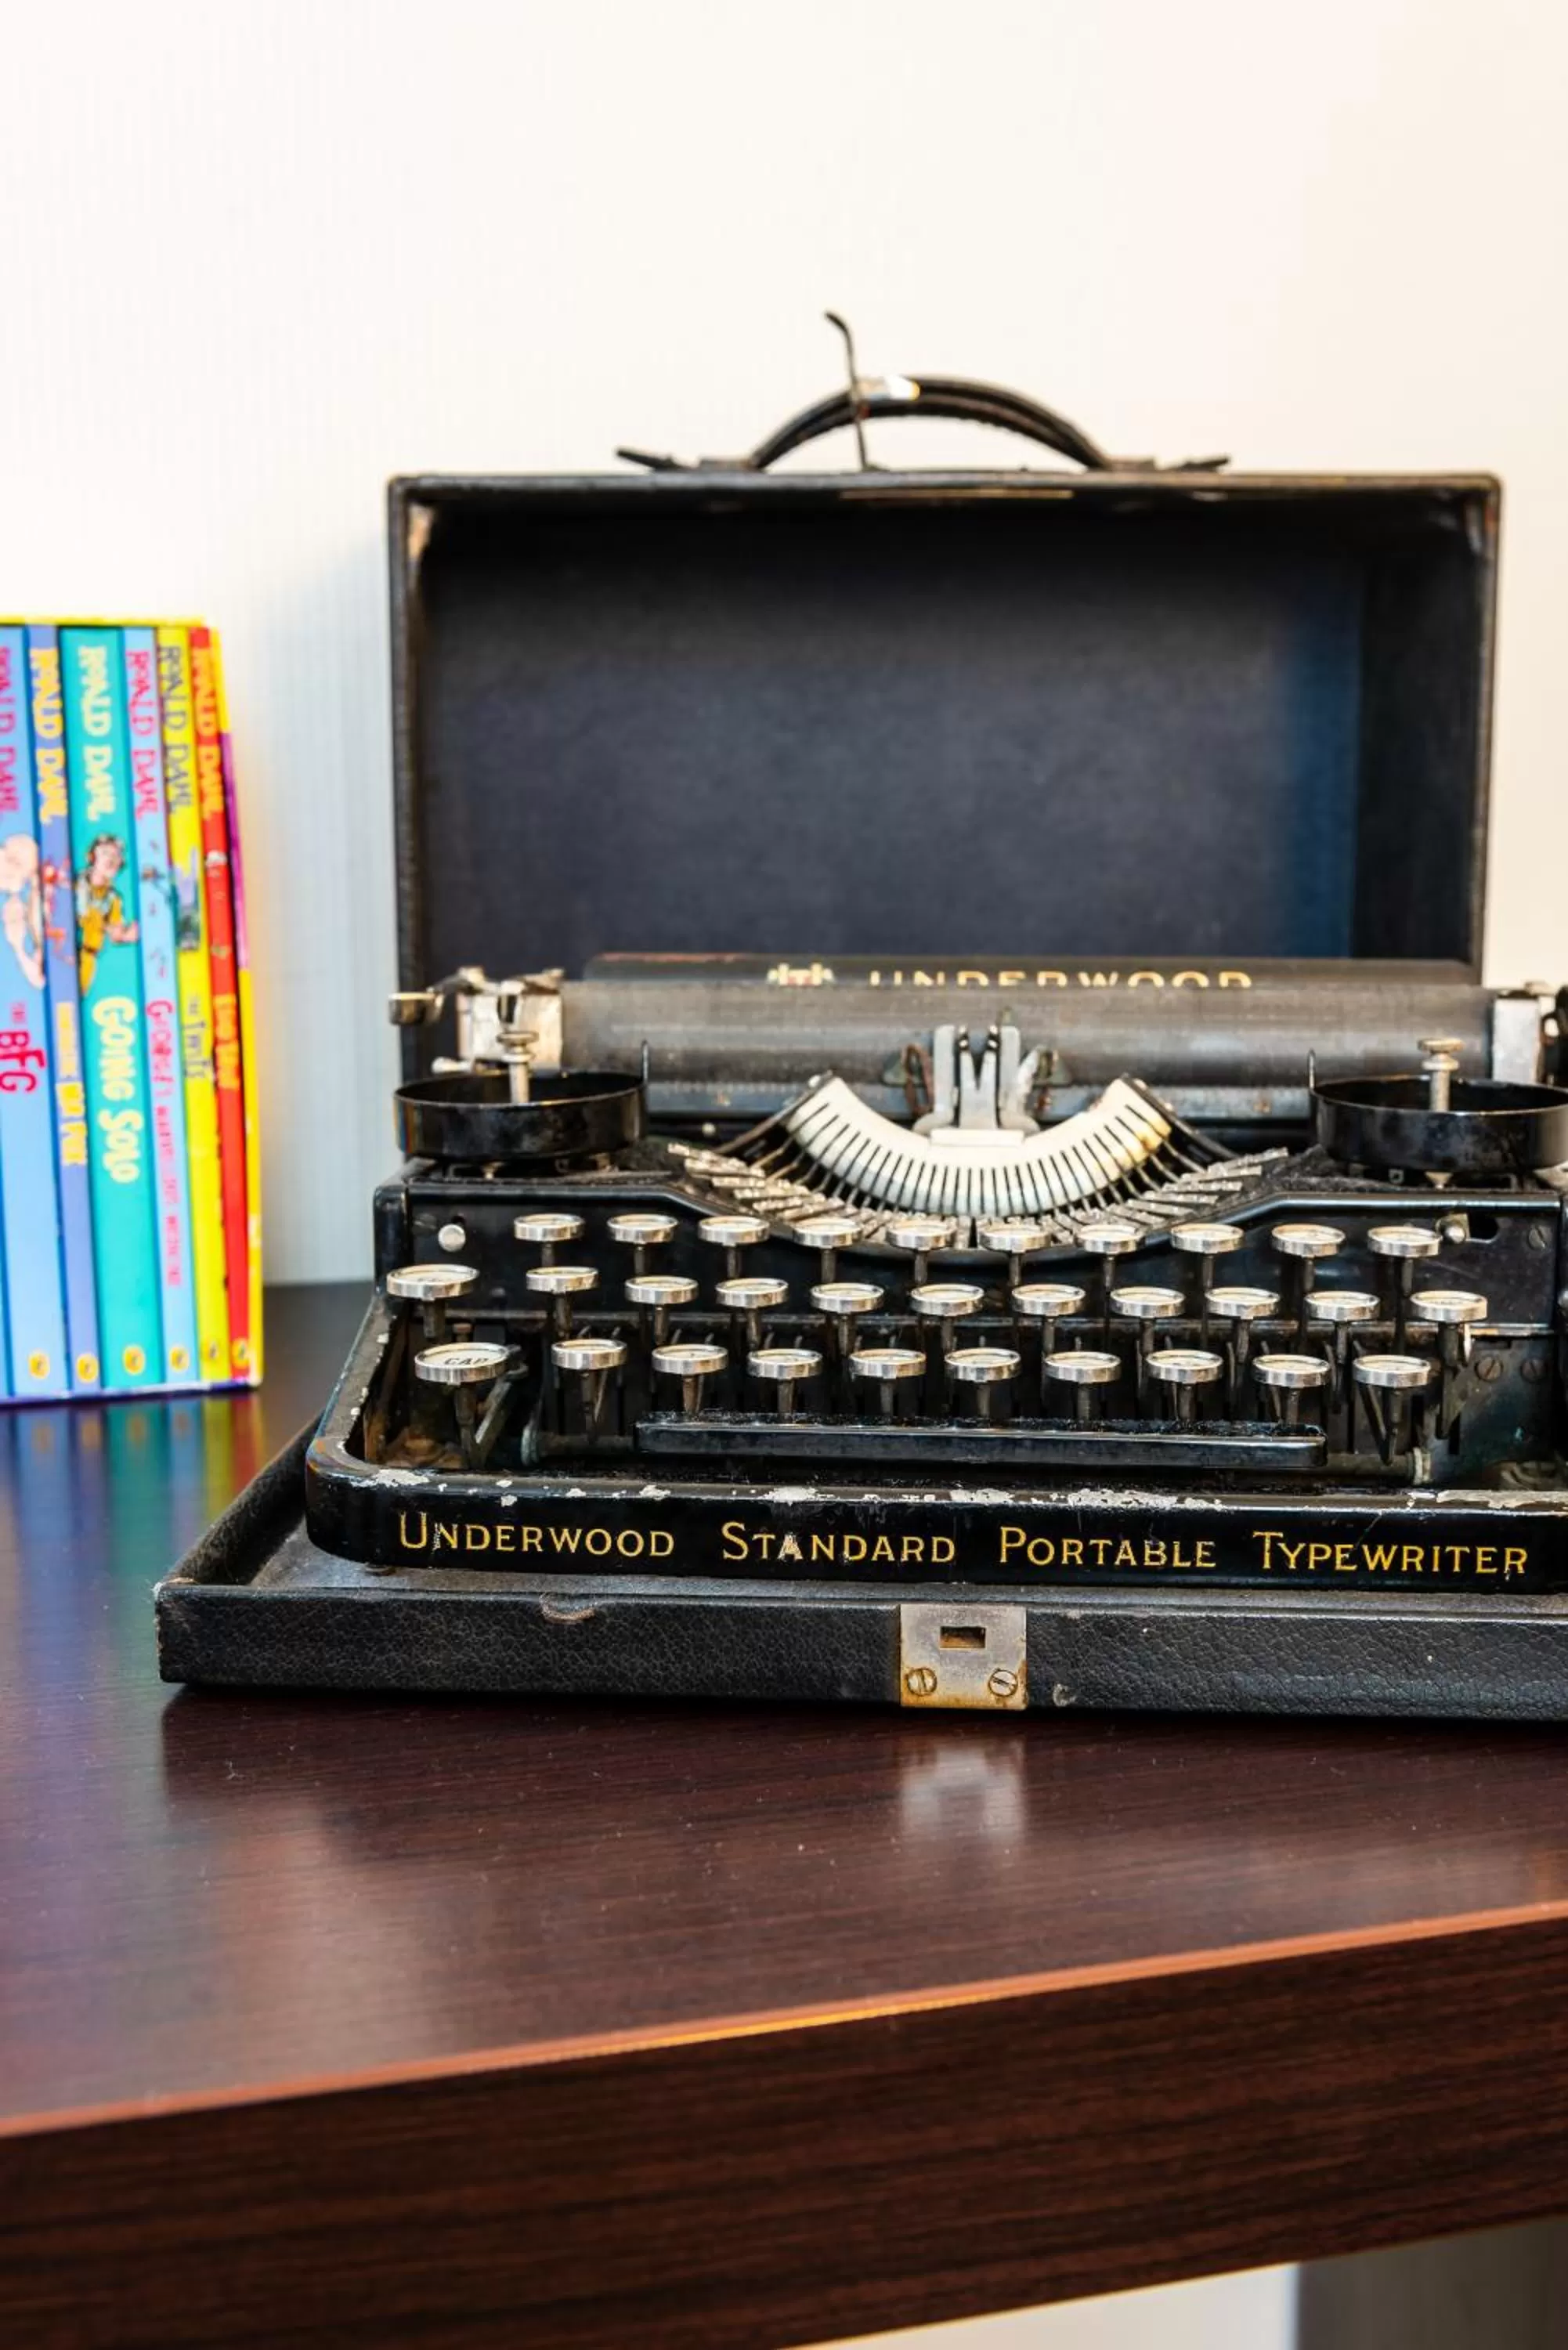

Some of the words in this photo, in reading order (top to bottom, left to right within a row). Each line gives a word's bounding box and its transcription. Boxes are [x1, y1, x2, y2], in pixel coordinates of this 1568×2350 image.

[82, 745, 116, 822] DAHL
[132, 749, 158, 820] DAHL
[164, 743, 193, 815] DAHL
[0, 1030, 45, 1094] BFG
[92, 996, 138, 1101] GOING
[97, 1108, 144, 1184] SOLO
[399, 1511, 675, 1558] UNDERWOOD
[721, 1521, 956, 1563] STANDARD
[999, 1526, 1216, 1567] PORTABLE
[1253, 1531, 1528, 1575] TYPEWRITER
